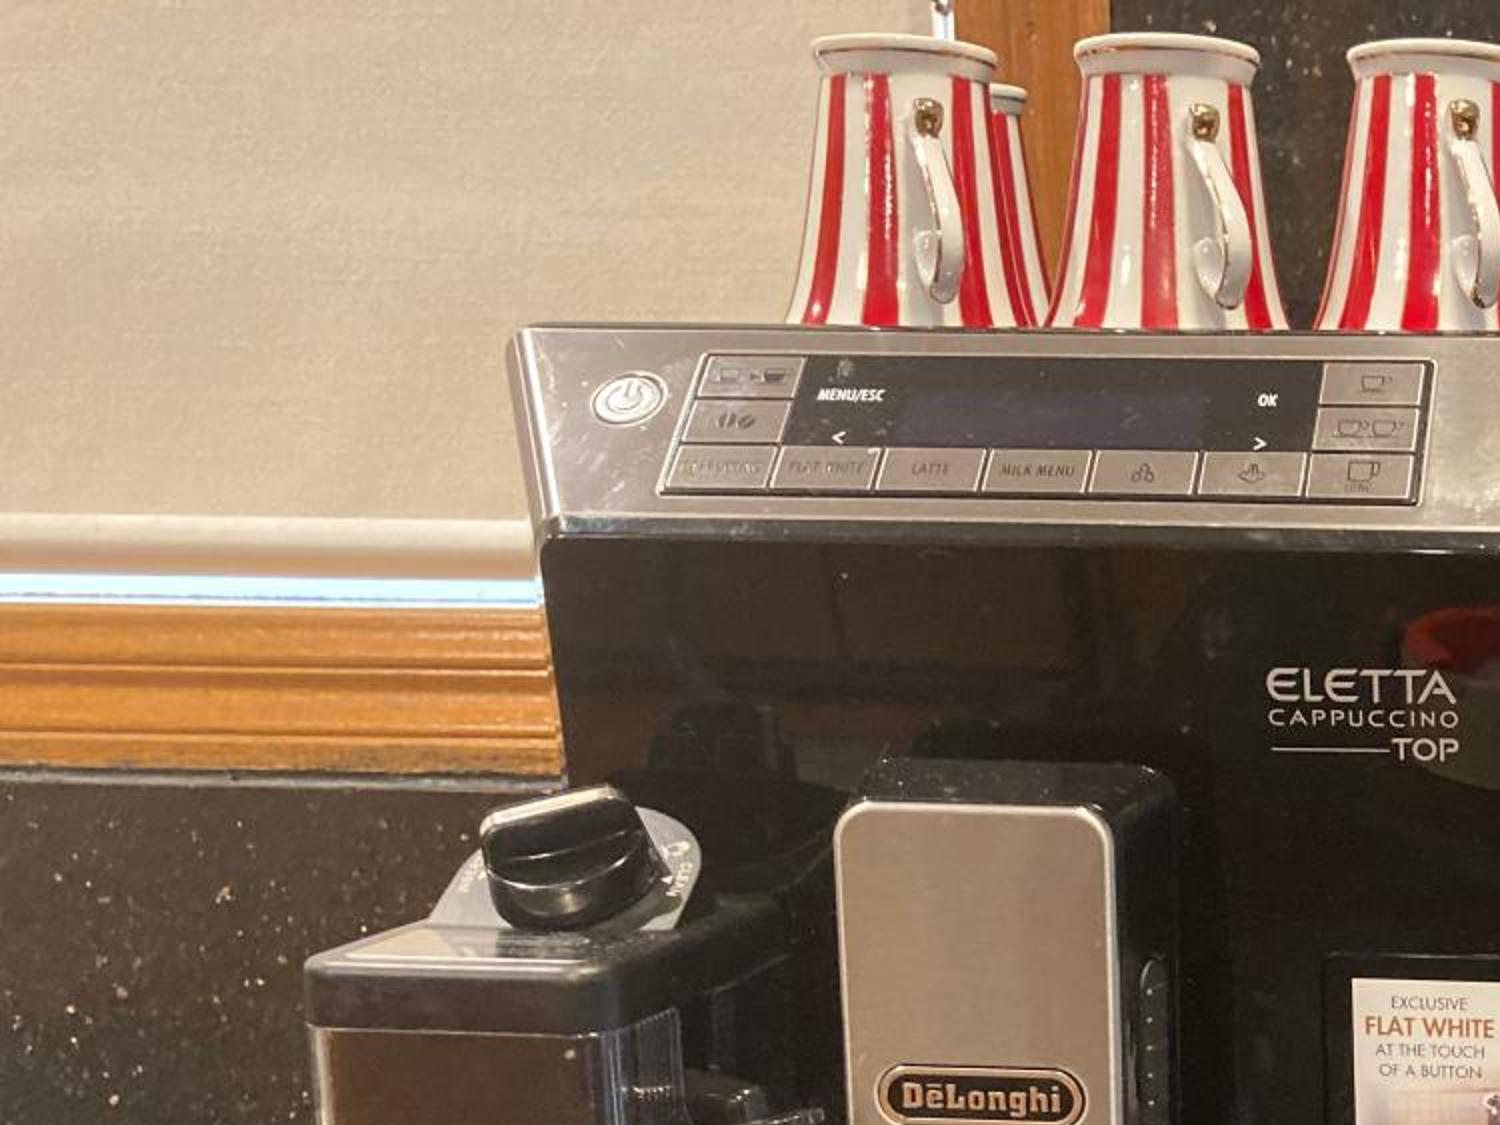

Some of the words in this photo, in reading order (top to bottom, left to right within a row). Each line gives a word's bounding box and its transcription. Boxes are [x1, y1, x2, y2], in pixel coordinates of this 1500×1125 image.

[816, 387, 888, 402] MENU/ESC
[1256, 392, 1280, 407] OK
[911, 462, 950, 476] LATTE
[1000, 464, 1033, 477] MILK
[1036, 464, 1076, 478] MENU
[1265, 667, 1457, 705] ELETTA
[1267, 708, 1459, 728] CAPPUCCINO
[1391, 737, 1459, 762] TOP
[1391, 995, 1470, 1011] EXCLUSIVE
[1364, 1015, 1416, 1037] FLAT
[1421, 1017, 1496, 1039] WHITE
[1375, 1043, 1394, 1056] AT
[1400, 1044, 1427, 1057] THE
[1430, 1045, 1486, 1059] TOUCH
[1378, 1063, 1399, 1077] OF
[1405, 1065, 1416, 1077] A
[1420, 1065, 1484, 1079] BUTTON
